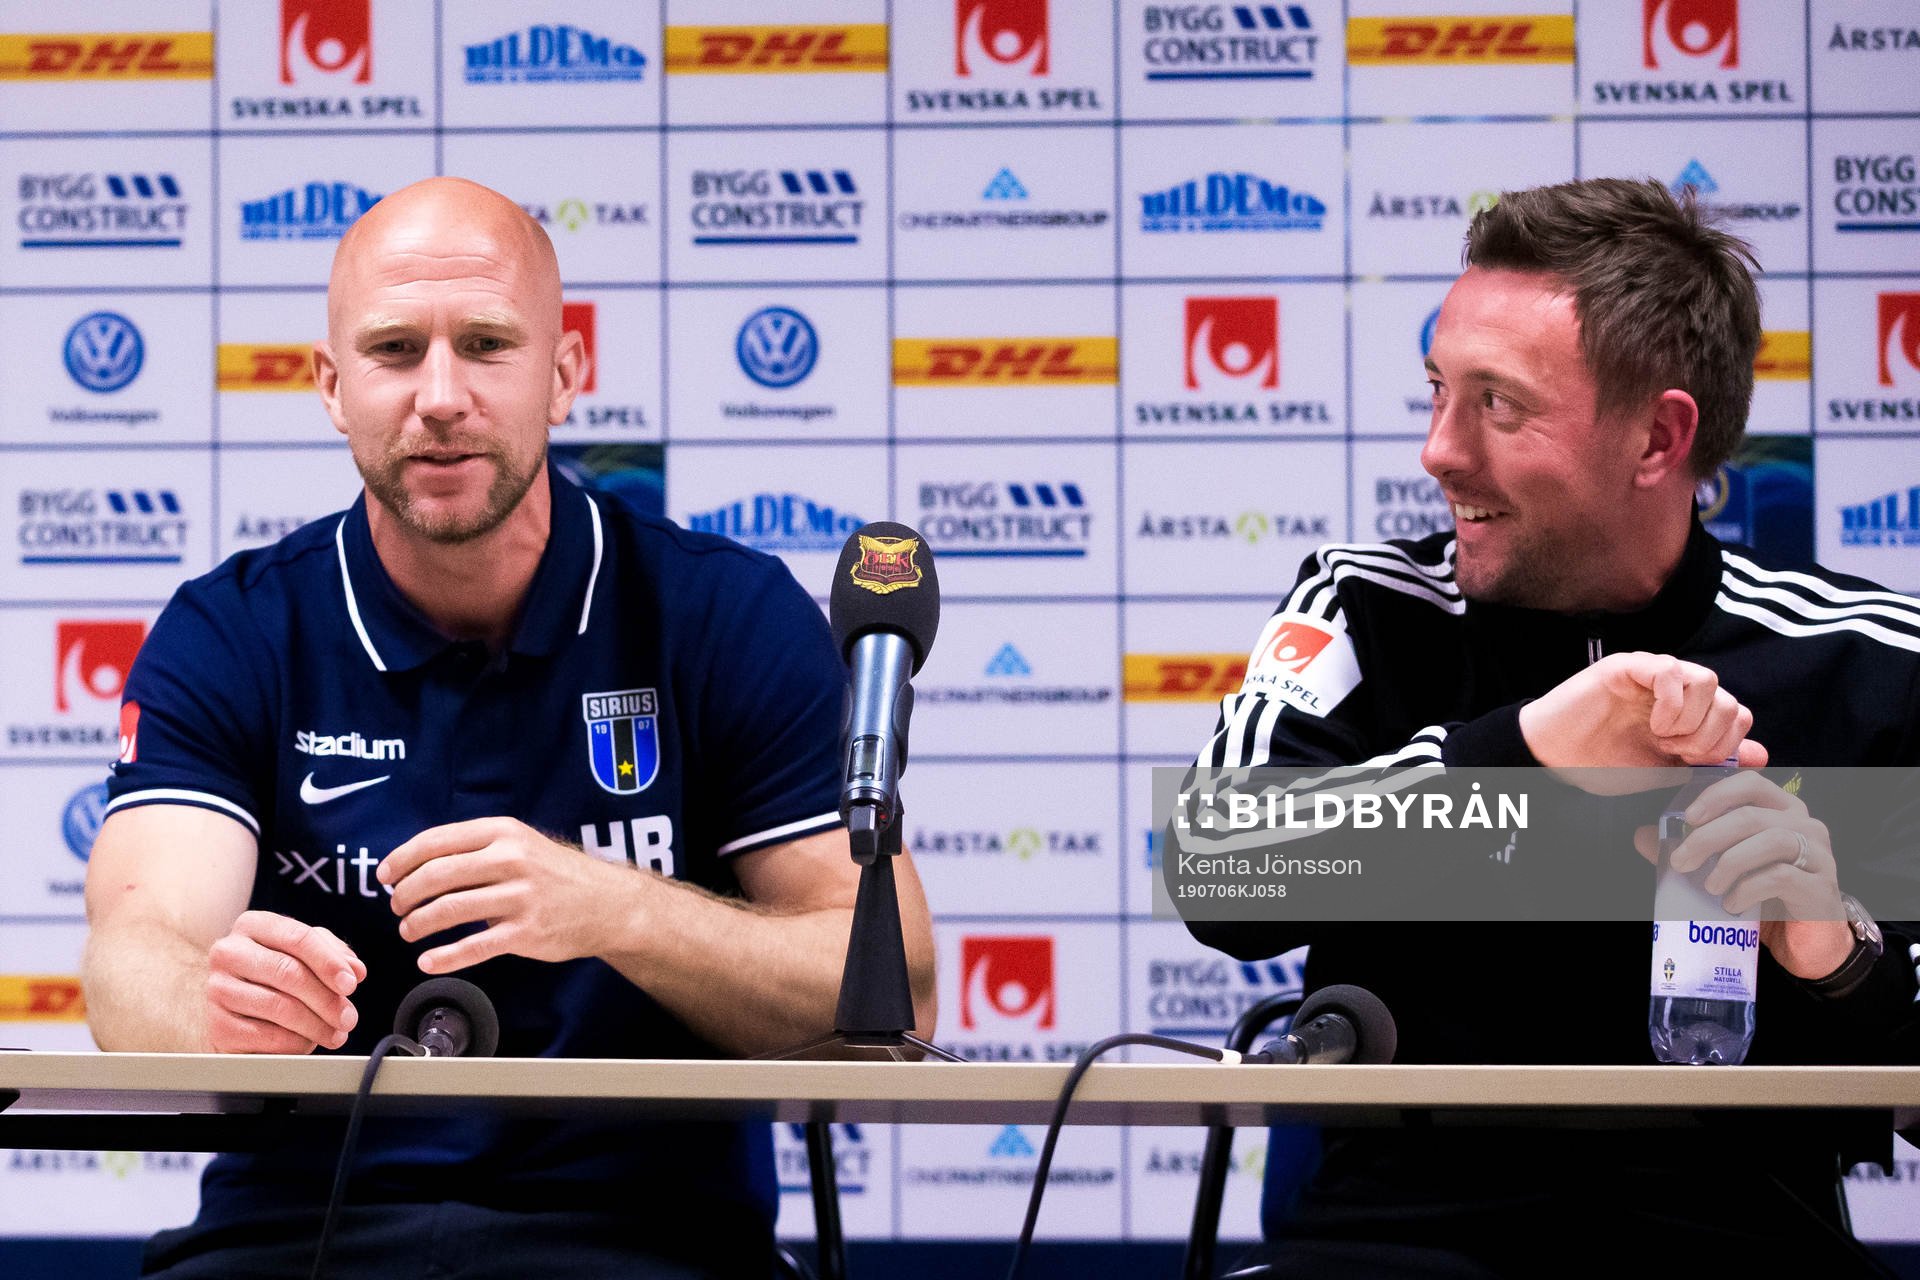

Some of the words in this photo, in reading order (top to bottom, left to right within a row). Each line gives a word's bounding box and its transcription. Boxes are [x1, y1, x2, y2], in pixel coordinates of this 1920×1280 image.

[1144, 6, 1223, 32] BYGG
[699, 33, 854, 65] DHL
[1144, 35, 1318, 64] CONSTRUCT
[1382, 24, 1541, 56] DHL
[28, 41, 181, 73] DHL
[907, 90, 1029, 111] SVENSKA
[1039, 88, 1100, 109] SPEL
[1594, 82, 1718, 103] SVENSKA
[1728, 81, 1792, 102] SPEL
[232, 97, 352, 119] SVENSKA
[362, 96, 422, 117] SPEL
[1834, 155, 1916, 183] BYGG
[19, 174, 96, 201] BYGG
[691, 171, 770, 197] BYGG
[595, 204, 647, 224] TAK
[691, 201, 863, 229] CONSTRUCT
[1369, 191, 1462, 217] ÅRSTA
[19, 204, 187, 232] CONSTRUCT
[928, 347, 1083, 378] DHL
[587, 407, 646, 427] SPEL
[1136, 404, 1258, 423] SVENSKA
[1270, 402, 1331, 423] SPEL
[19, 491, 96, 516] BYGG
[919, 483, 998, 509] BYGG
[19, 521, 187, 548] CONSTRUCT
[918, 514, 1092, 542] CONSTRUCT
[1138, 511, 1231, 538] ÅRSTA
[1275, 516, 1328, 536] TAK
[589, 695, 652, 718] SIRIUS
[1281, 679, 1321, 710] SPEL
[594, 724, 608, 734] 19
[294, 730, 406, 760] stadium
[580, 815, 674, 878] HR
[911, 827, 1003, 854] ÅRSTA
[1048, 831, 1101, 853] TAK
[1689, 920, 1759, 952] bonaqua
[1714, 966, 1742, 977] STILLA
